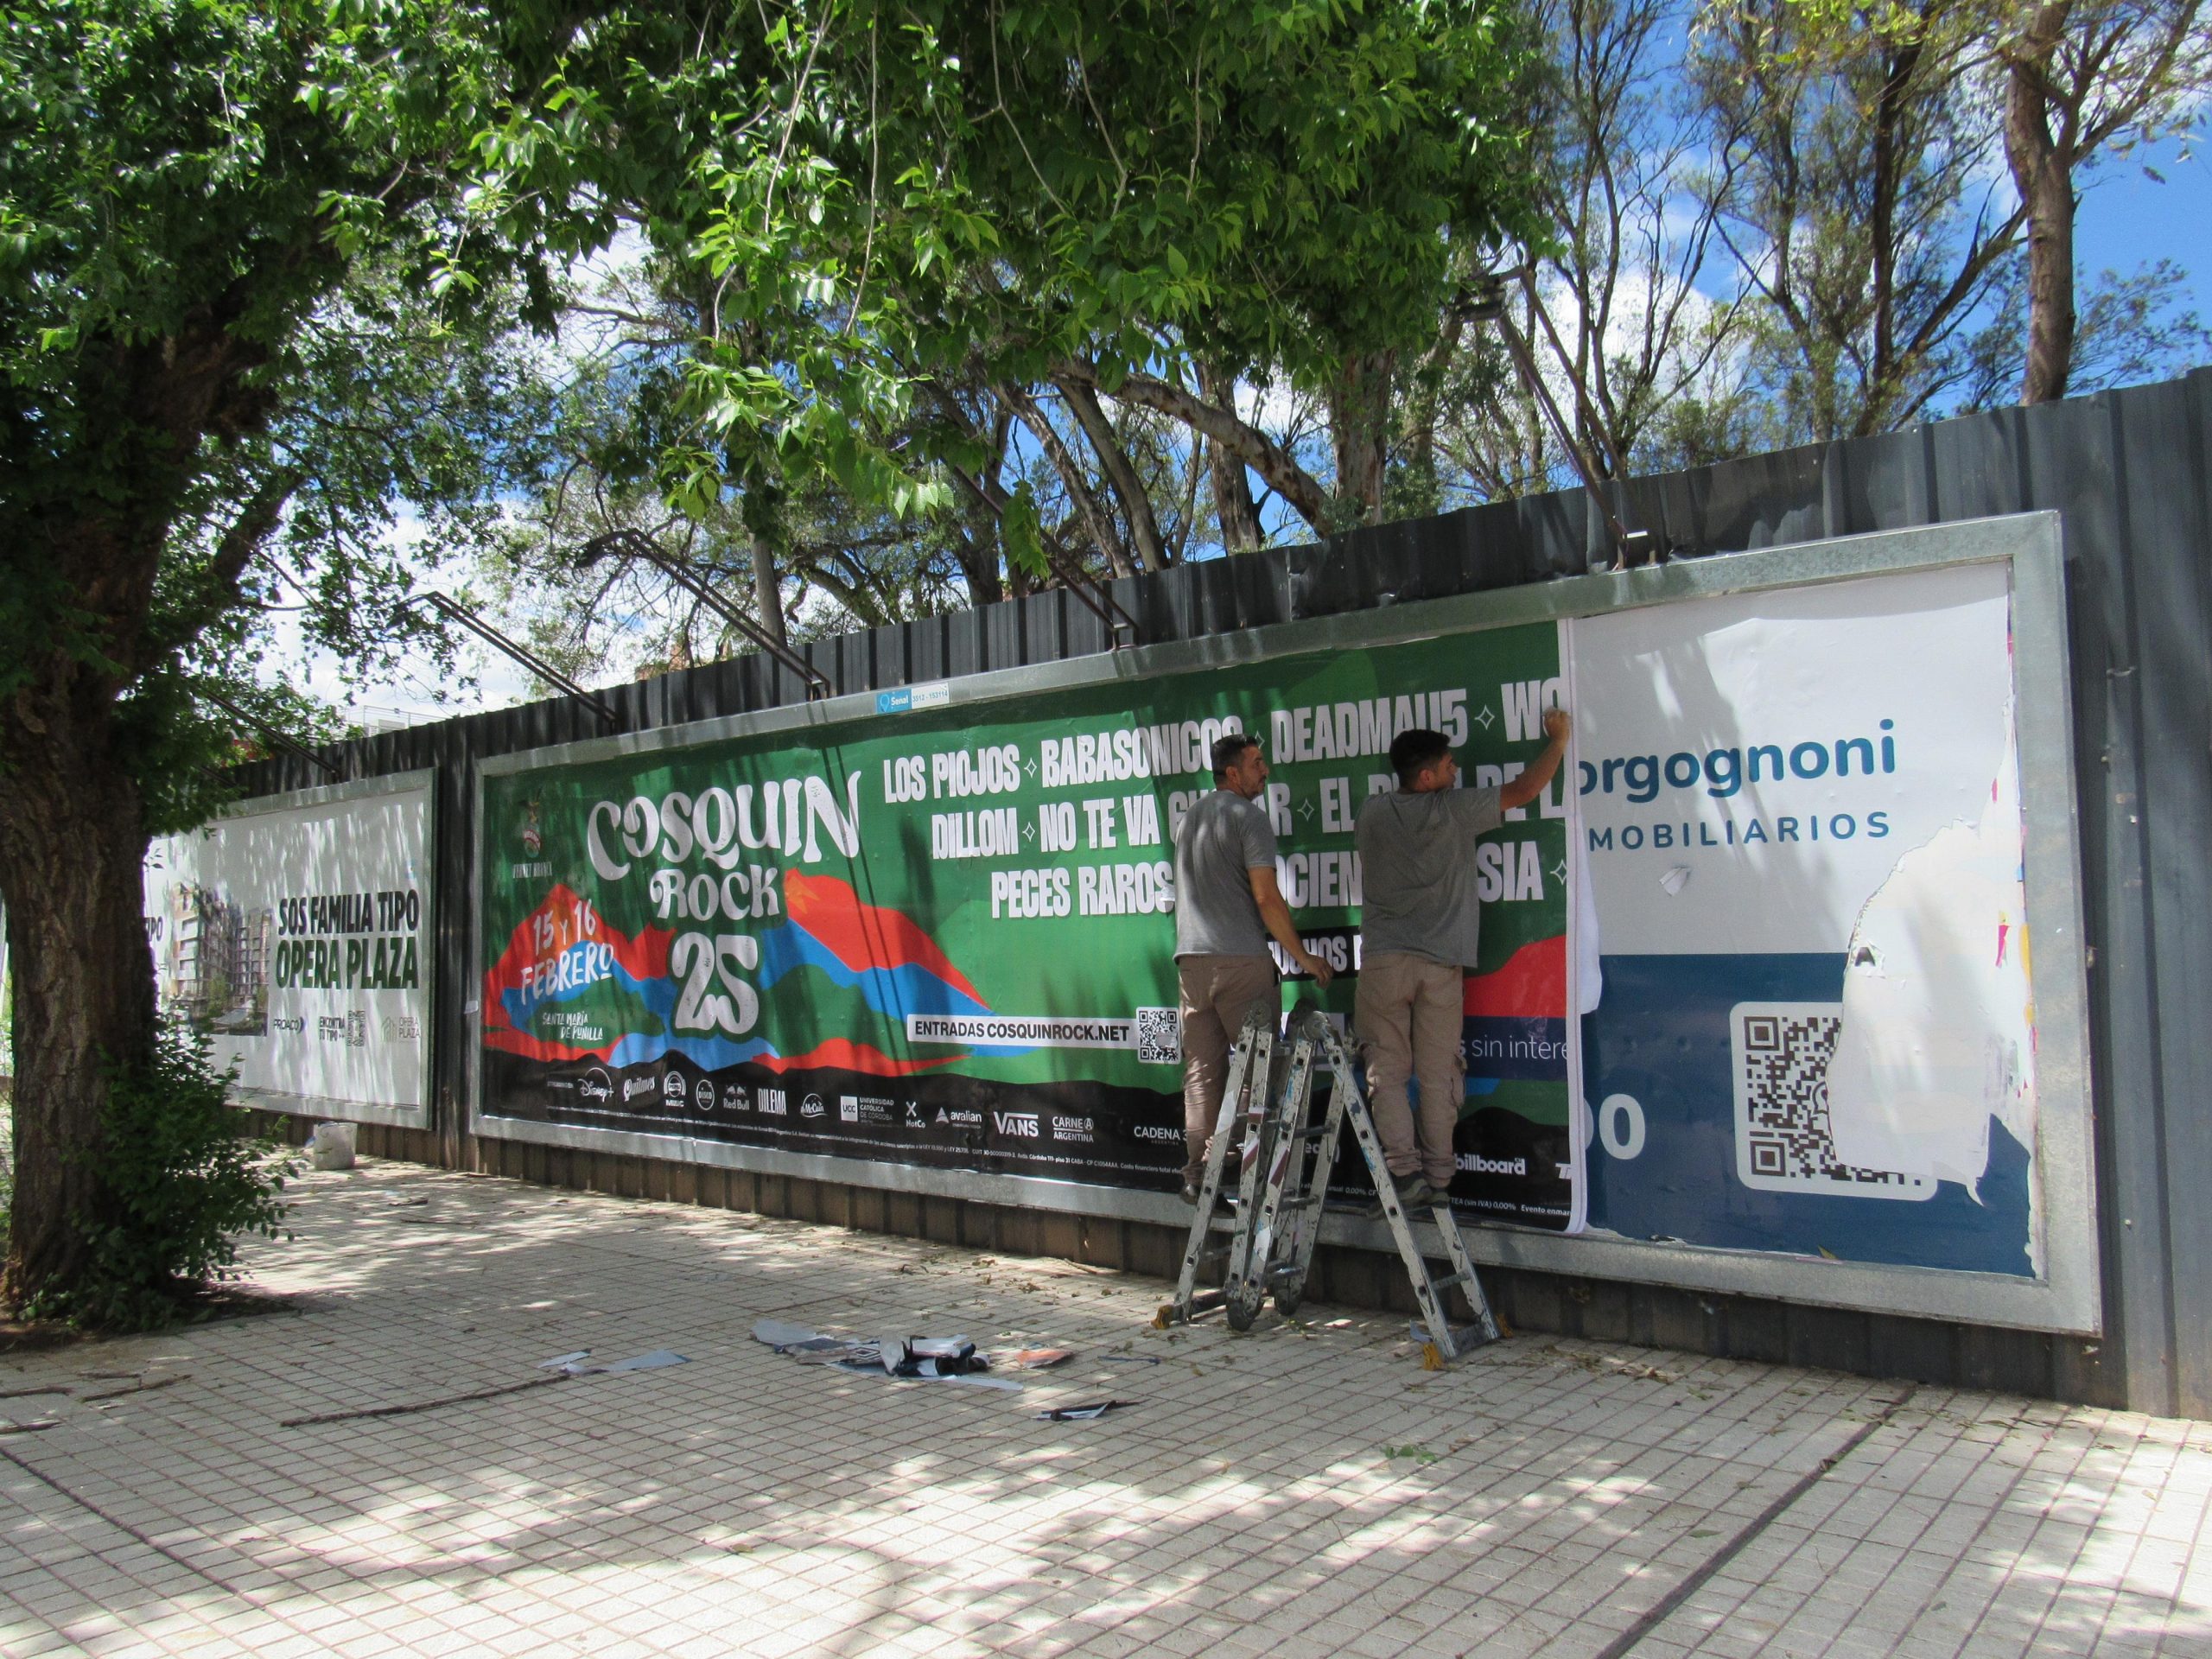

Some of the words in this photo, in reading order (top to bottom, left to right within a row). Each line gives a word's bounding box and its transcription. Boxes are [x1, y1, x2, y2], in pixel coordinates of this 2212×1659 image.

[883, 755, 926, 804] LOS
[931, 744, 1020, 798] PIOJOS
[588, 770, 862, 880] COSQUIN
[931, 807, 1019, 860] DILLOM
[1039, 802, 1077, 853] NO
[1083, 798, 1116, 849] TE
[1123, 793, 1161, 846] VA
[1319, 778, 1354, 833] EL
[650, 864, 780, 921] ROCK
[991, 867, 1071, 919] PECES
[1078, 861, 1174, 916] RAROS
[278, 896, 308, 936] SOS
[310, 893, 374, 935] FAMILIA
[378, 888, 420, 932] TIPO
[533, 910, 554, 957] 15
[559, 921, 569, 945] Y
[574, 899, 596, 943] 16
[276, 938, 340, 989] OPERA
[346, 937, 419, 989] PLAZA
[520, 942, 614, 1006] FEBRERO
[671, 931, 759, 1034] 25
[399, 1016, 418, 1027] OPERA
[543, 1012, 564, 1025] SANTA
[398, 1027, 420, 1039] PLAZA
[560, 1027, 570, 1039] DE
[572, 1026, 603, 1041] PUNILLA
[915, 1020, 984, 1037] ENTRADAS
[987, 1023, 1129, 1042] COSQUINROCK.NET
[1471, 1035, 1503, 1058] sin
[723, 1098, 735, 1109] Red
[737, 1100, 750, 1110] Bull
[758, 1088, 787, 1116] DILEMA
[860, 1097, 894, 1106] UNIVERSIDAD
[950, 1110, 982, 1122] avalian
[994, 1111, 1039, 1137] VANS
[1052, 1116, 1084, 1128] CARNE
[1584, 1093, 1646, 1160] 0
[1053, 1131, 1094, 1143] ARGENTINA
[1134, 1126, 1180, 1141] CADENA
[1135, 1164, 1159, 1173] financiero
[1453, 1153, 1526, 1175] billboard
[1452, 1197, 1464, 1205] TEA
[1478, 1200, 1492, 1209] IVA)
[1521, 1204, 1546, 1214] Evento
